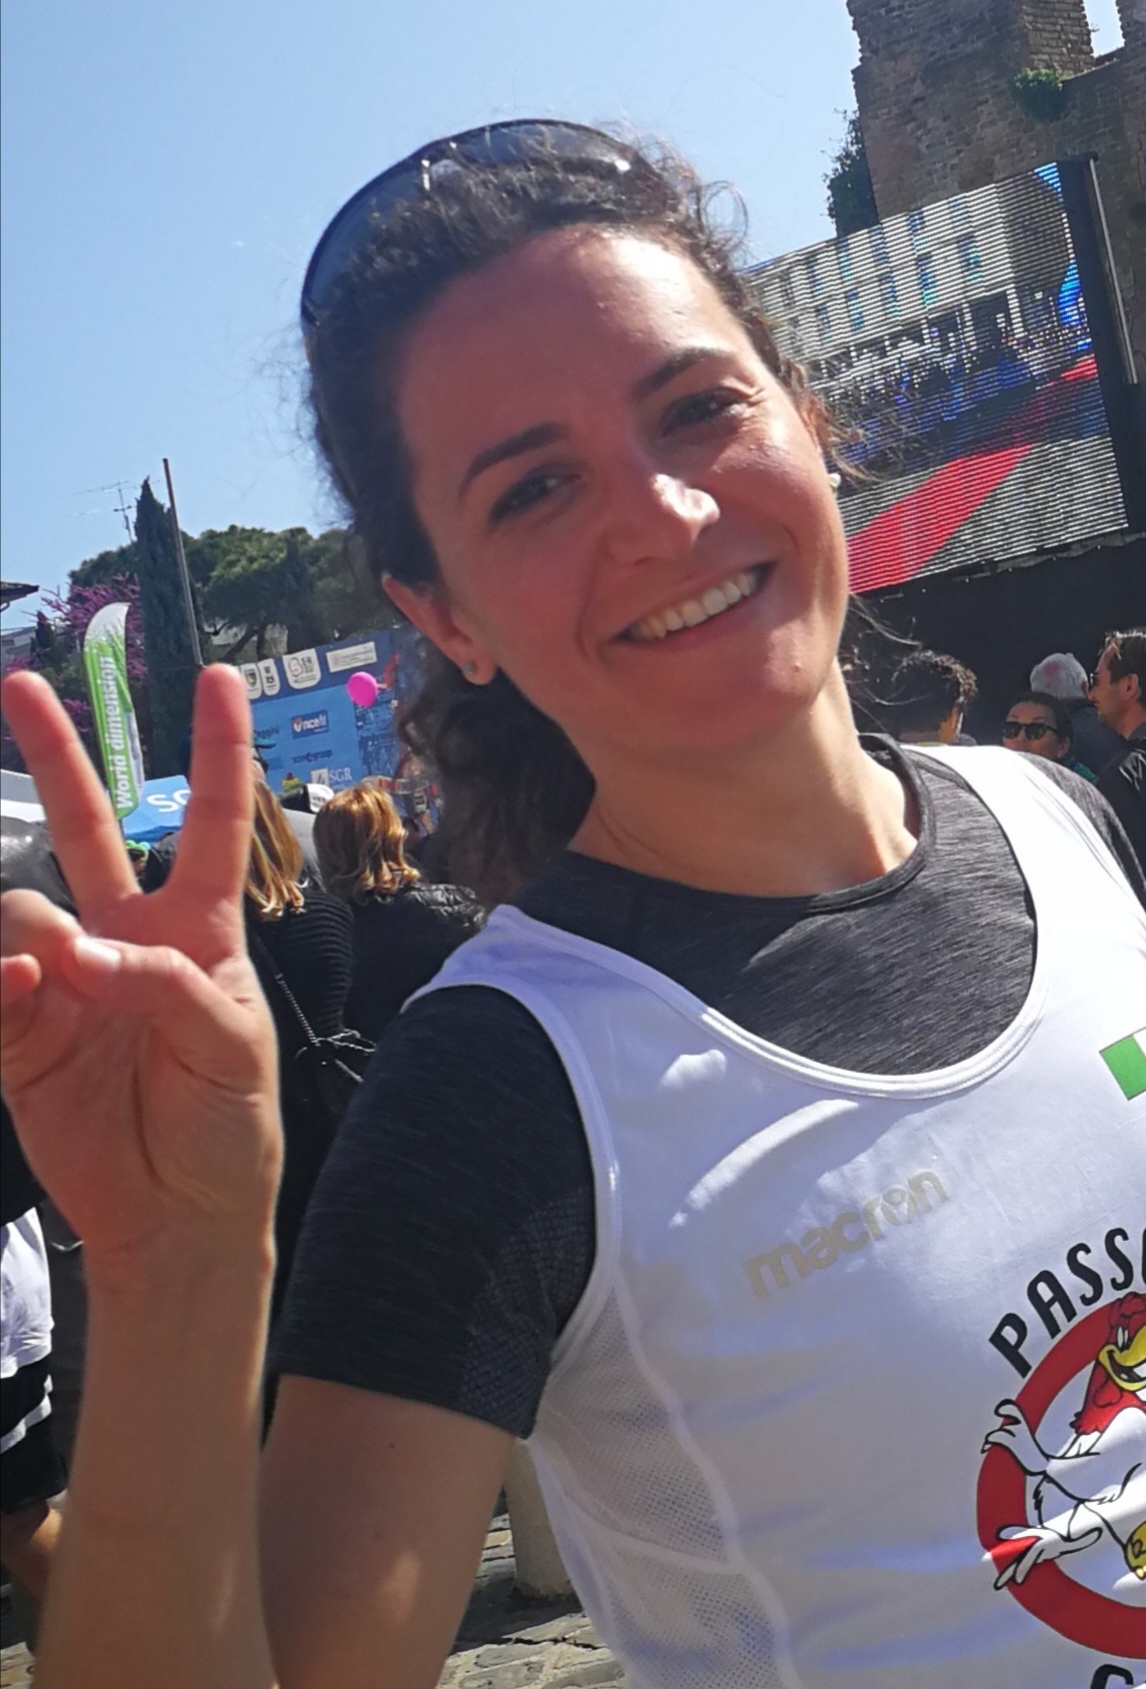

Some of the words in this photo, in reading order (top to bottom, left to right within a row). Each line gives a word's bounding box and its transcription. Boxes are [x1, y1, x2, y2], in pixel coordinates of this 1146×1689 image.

[97, 655, 125, 750] dimension
[109, 755, 134, 809] World
[328, 766, 353, 783] SGR
[743, 1170, 949, 1298] macron
